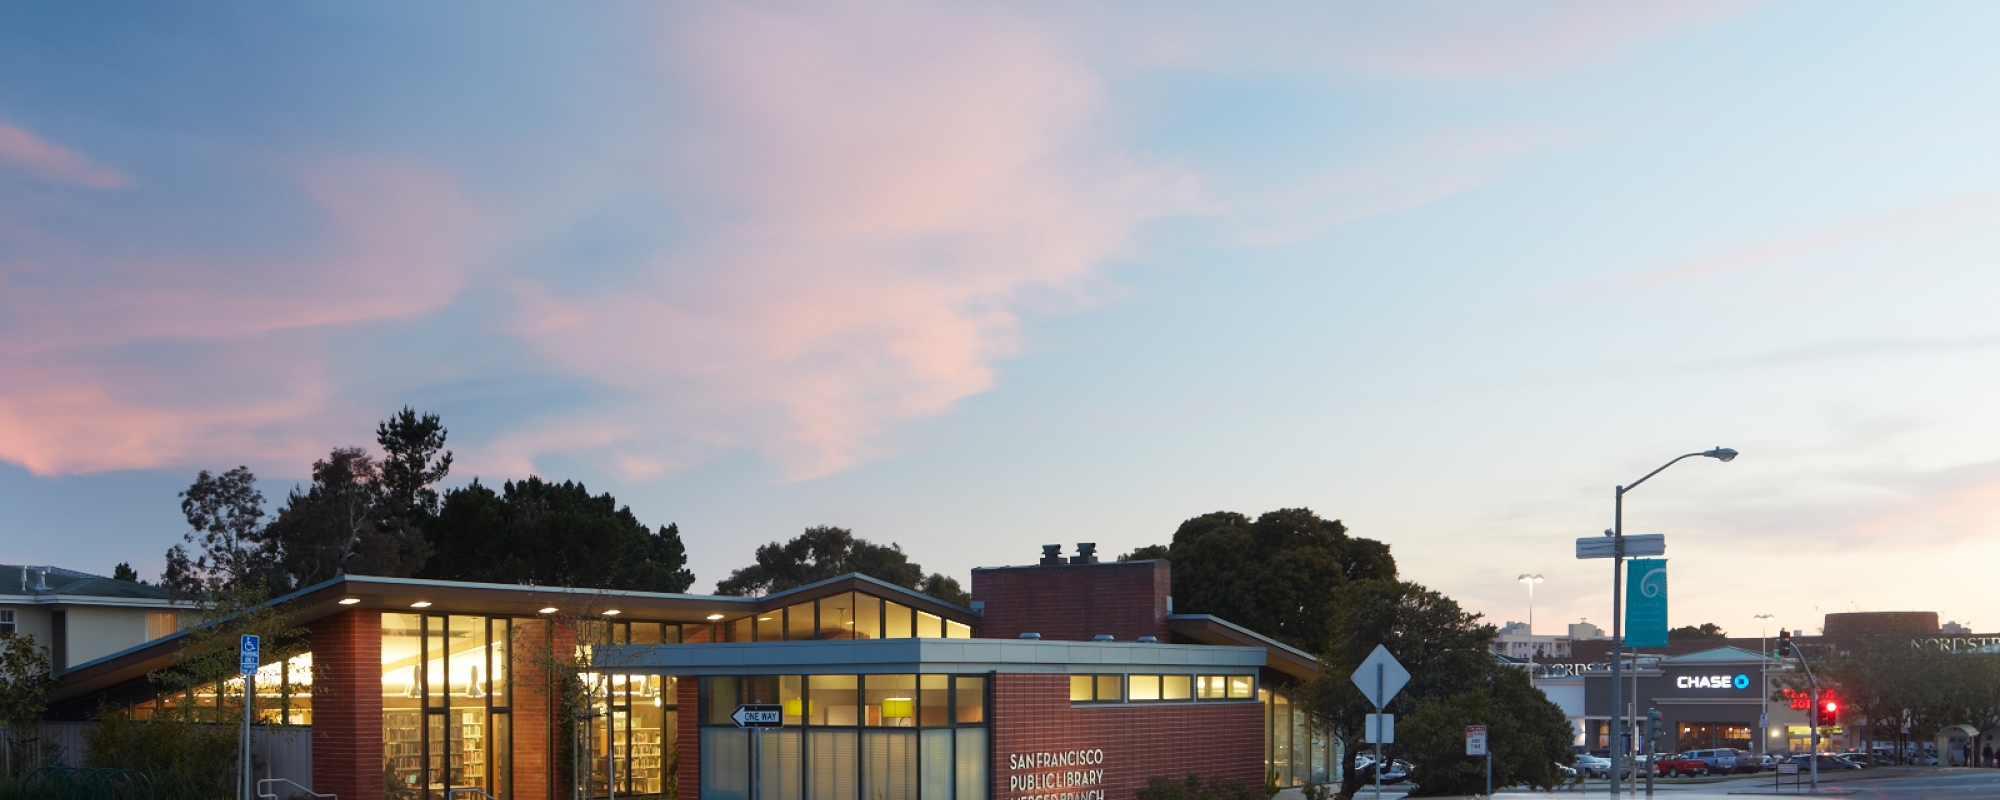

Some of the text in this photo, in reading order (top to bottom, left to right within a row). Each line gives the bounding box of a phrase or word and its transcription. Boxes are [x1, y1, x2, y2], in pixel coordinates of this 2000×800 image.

[1677, 675, 1732, 689] CHASE
[745, 712, 776, 721] ONE WAY
[1010, 748, 1103, 770] SAN FRANCISCO
[1010, 769, 1103, 792] PUBLIC LIBRARY
